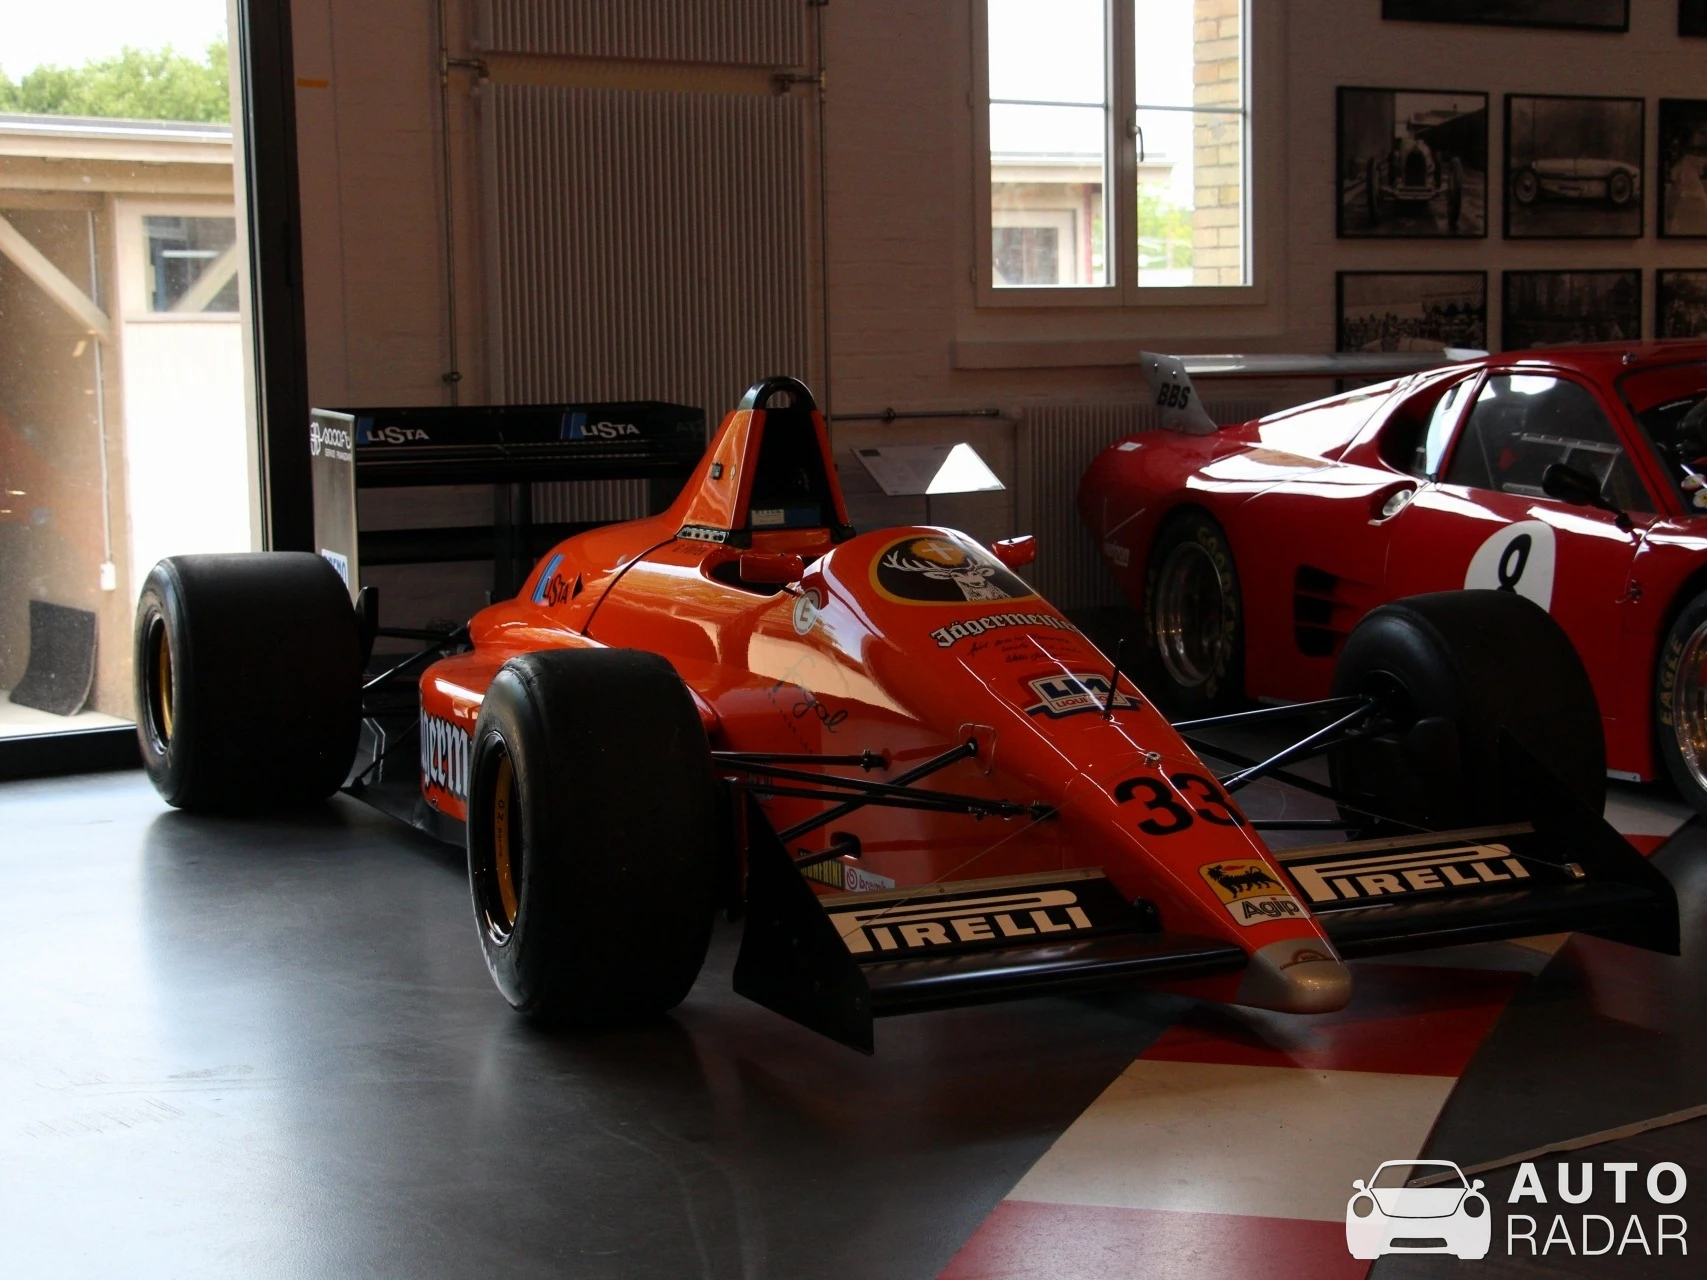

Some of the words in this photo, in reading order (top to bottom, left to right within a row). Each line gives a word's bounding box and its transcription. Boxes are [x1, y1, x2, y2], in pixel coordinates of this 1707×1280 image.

[1156, 383, 1190, 409] BBS
[366, 426, 430, 444] LISTA
[580, 421, 640, 439] LISTA
[1056, 697, 1089, 708] LIQUI
[1114, 772, 1246, 836] 33
[859, 875, 888, 892] bremb
[1288, 843, 1531, 903] PIRELLI
[1241, 897, 1300, 920] Agip
[828, 889, 1093, 954] PIRELLI
